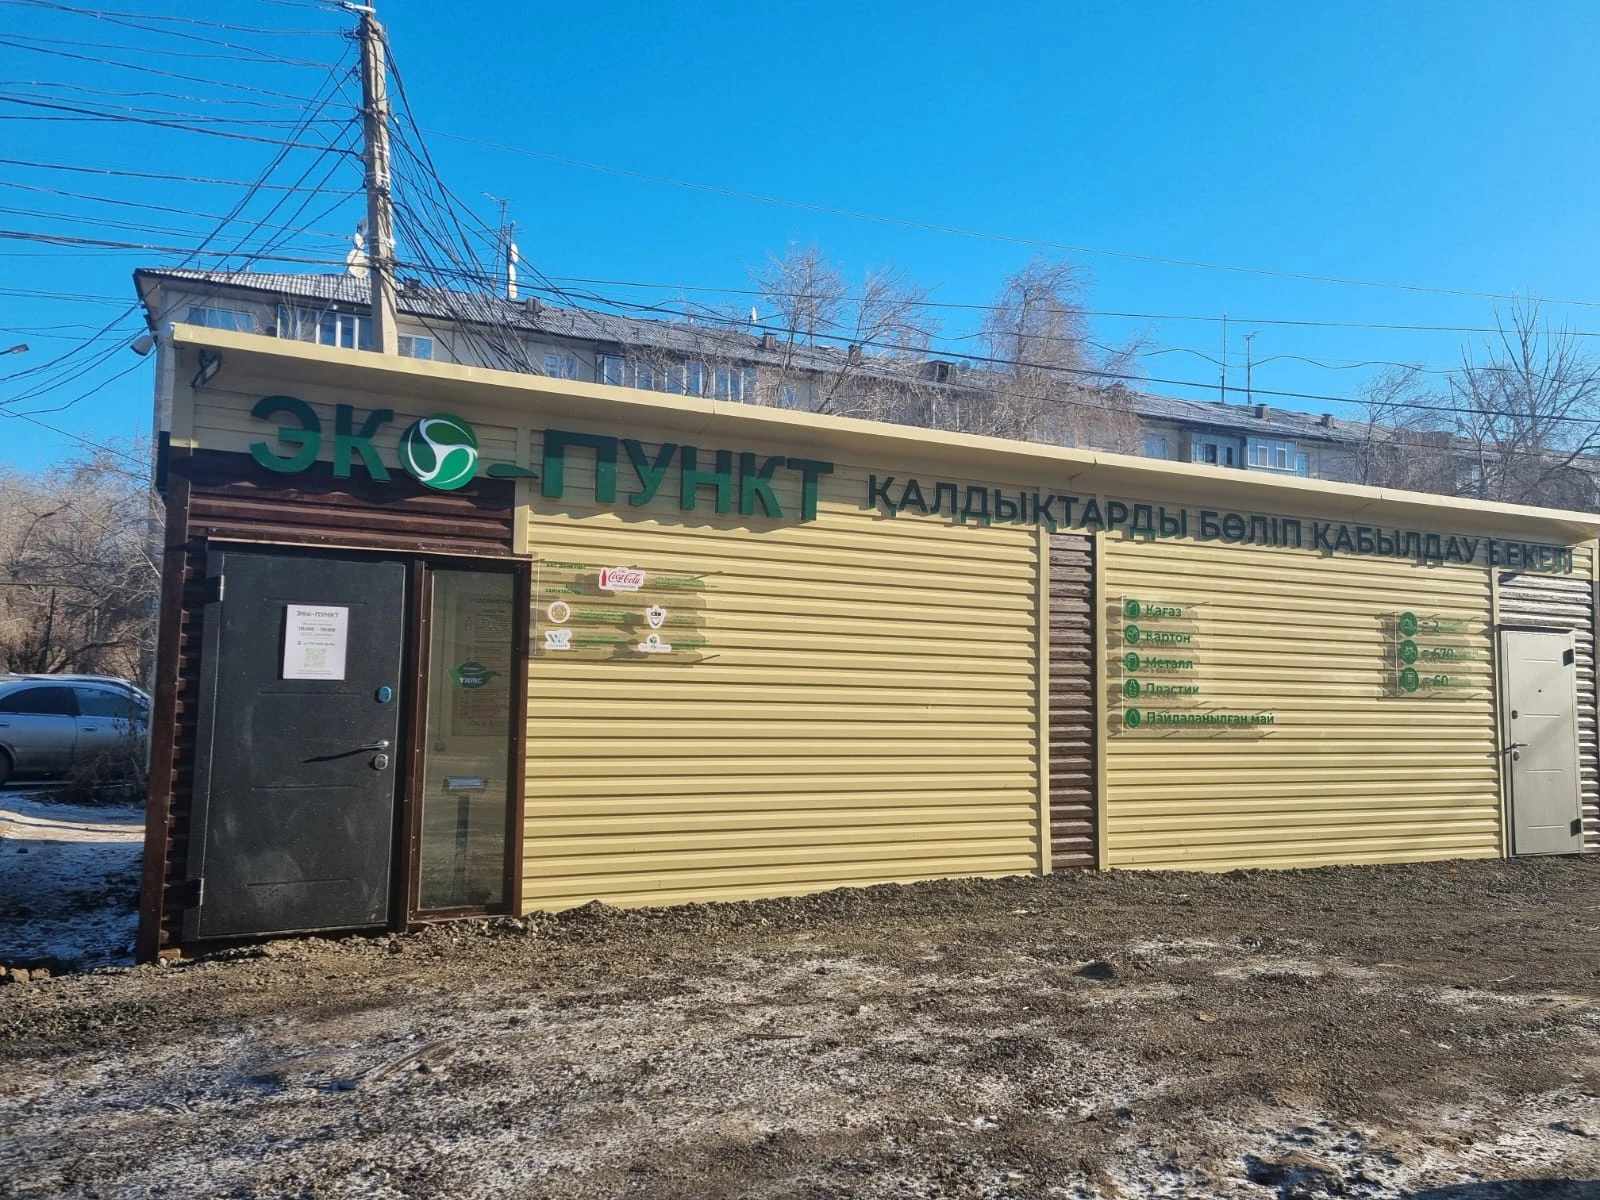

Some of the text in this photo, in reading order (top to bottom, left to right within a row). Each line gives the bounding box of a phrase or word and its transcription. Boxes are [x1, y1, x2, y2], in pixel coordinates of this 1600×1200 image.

[867, 474, 1188, 541] ҚАЛДЫҚТАРДЫ
[1199, 510, 1302, 548] БӨЛІП
[1313, 521, 1480, 566] ҚАБЫЛДАУ
[1146, 632, 1191, 645] Картон
[1145, 656, 1193, 669] Металл
[1146, 682, 1200, 695] Пластик
[1146, 711, 1275, 725] Пайдаланылған май
